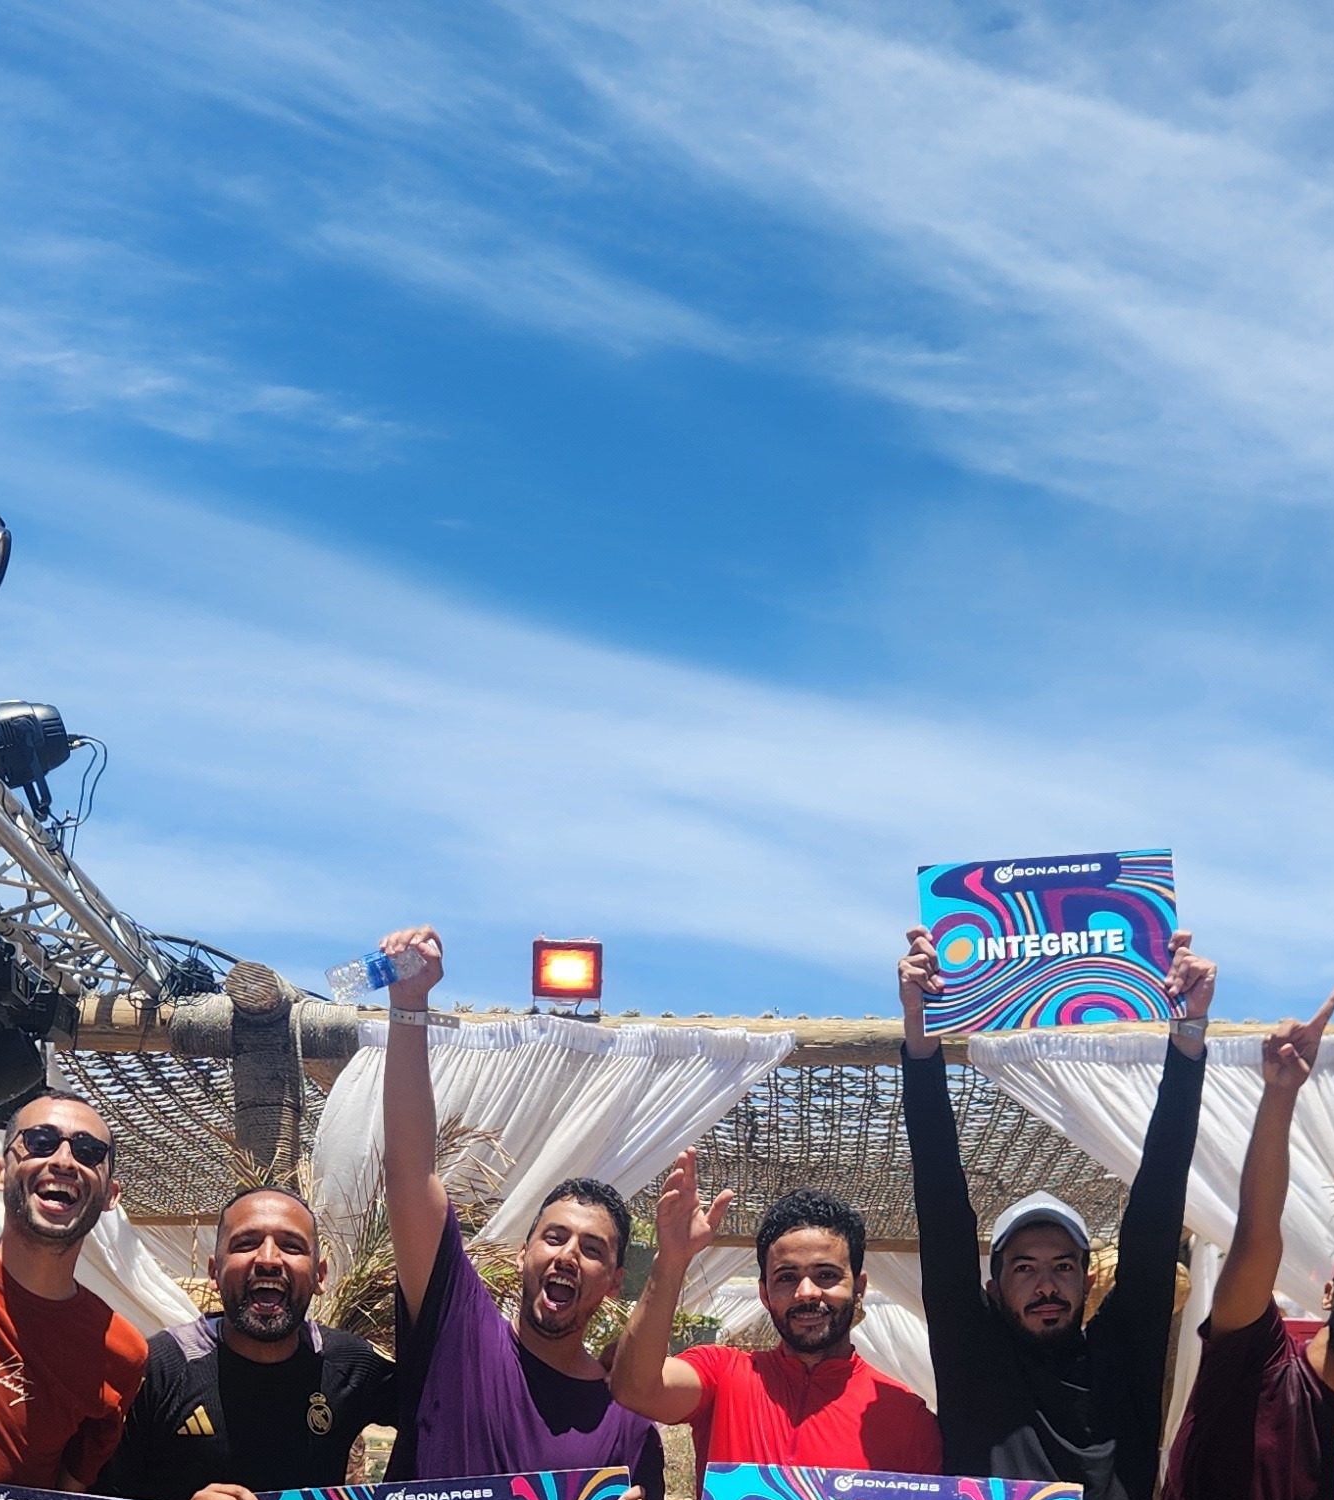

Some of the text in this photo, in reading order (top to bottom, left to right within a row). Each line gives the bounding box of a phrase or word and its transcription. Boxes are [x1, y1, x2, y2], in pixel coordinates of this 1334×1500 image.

[1014, 863, 1101, 877] SONARGES
[978, 929, 1126, 962] INTEGRITE
[853, 1478, 940, 1493] SONARGES
